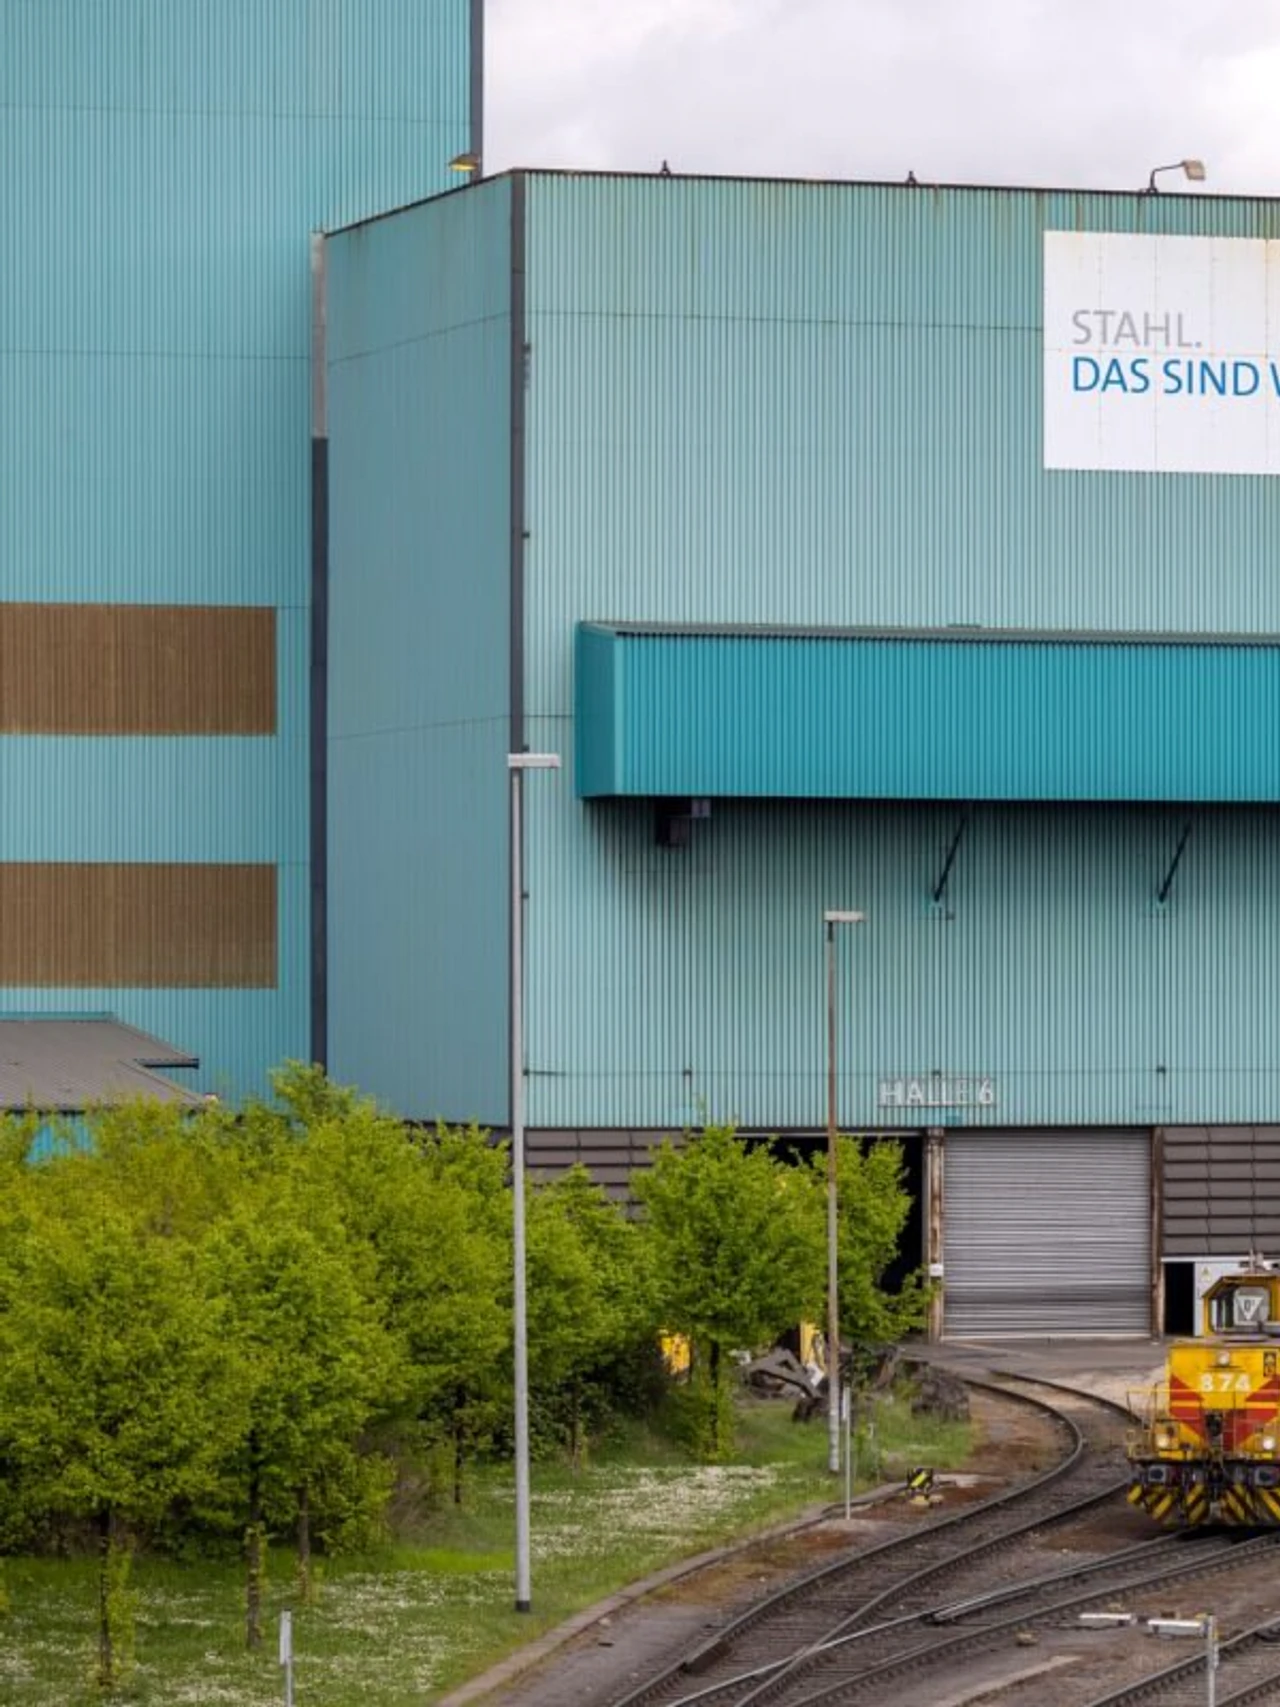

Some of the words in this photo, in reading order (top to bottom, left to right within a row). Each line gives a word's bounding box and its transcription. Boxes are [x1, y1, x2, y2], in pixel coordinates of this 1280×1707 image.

[1072, 309, 1202, 348] STAHL.
[1073, 356, 1150, 393] DAS
[1162, 358, 1260, 396] SIND
[880, 1079, 968, 1106] HALLE
[979, 1079, 994, 1105] 6
[1200, 1372, 1251, 1392] 874
